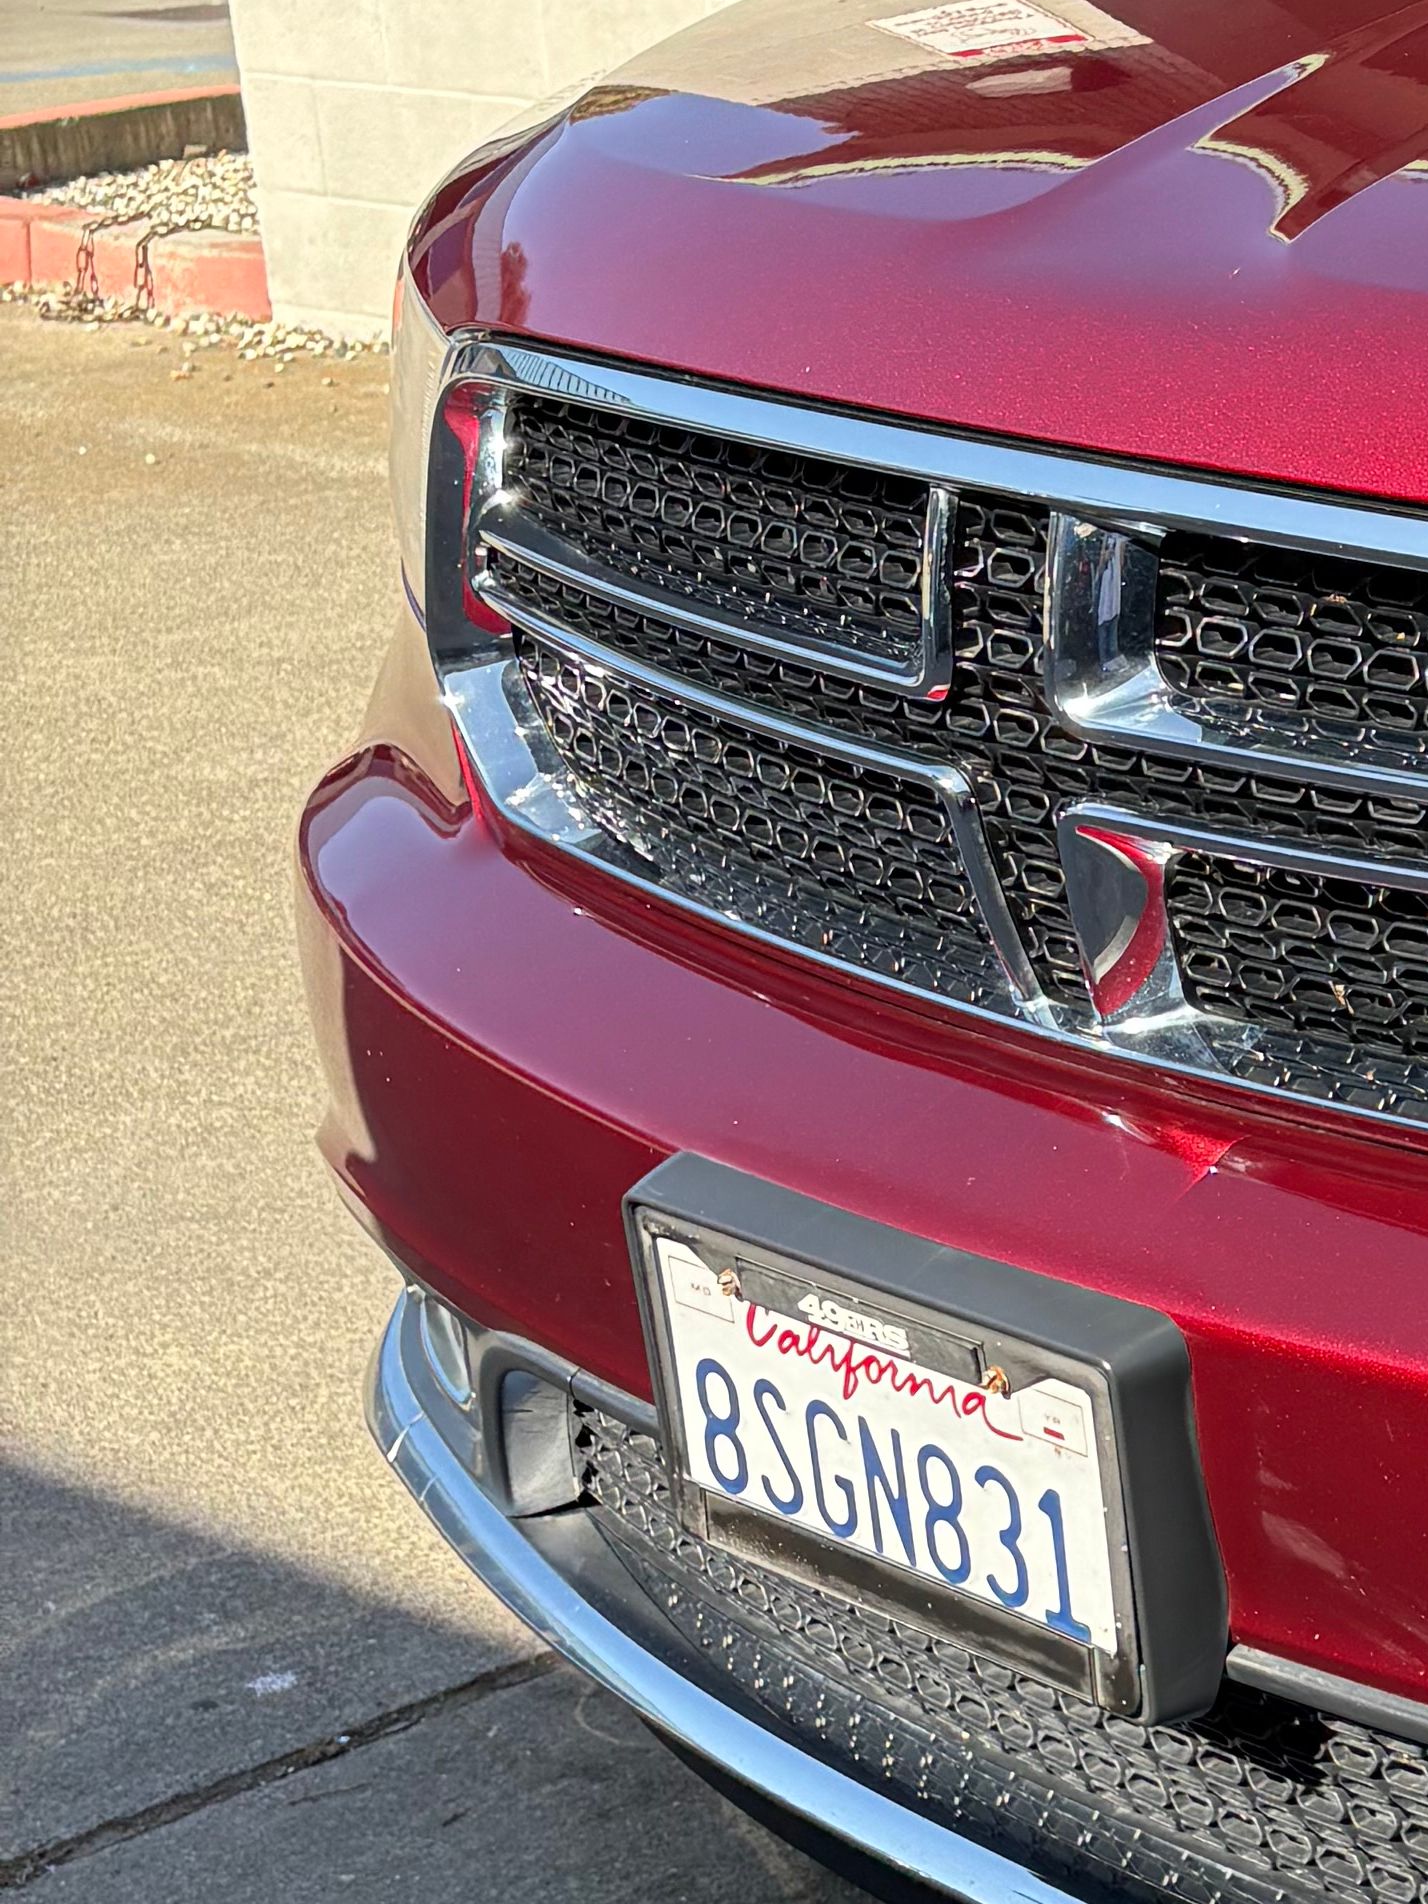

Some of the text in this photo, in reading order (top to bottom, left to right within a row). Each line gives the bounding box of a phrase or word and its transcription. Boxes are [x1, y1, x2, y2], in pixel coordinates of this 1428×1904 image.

[746, 1303, 1023, 1441] California
[797, 1293, 911, 1352] 49ERS
[695, 1358, 1092, 1645] 8SGN831
